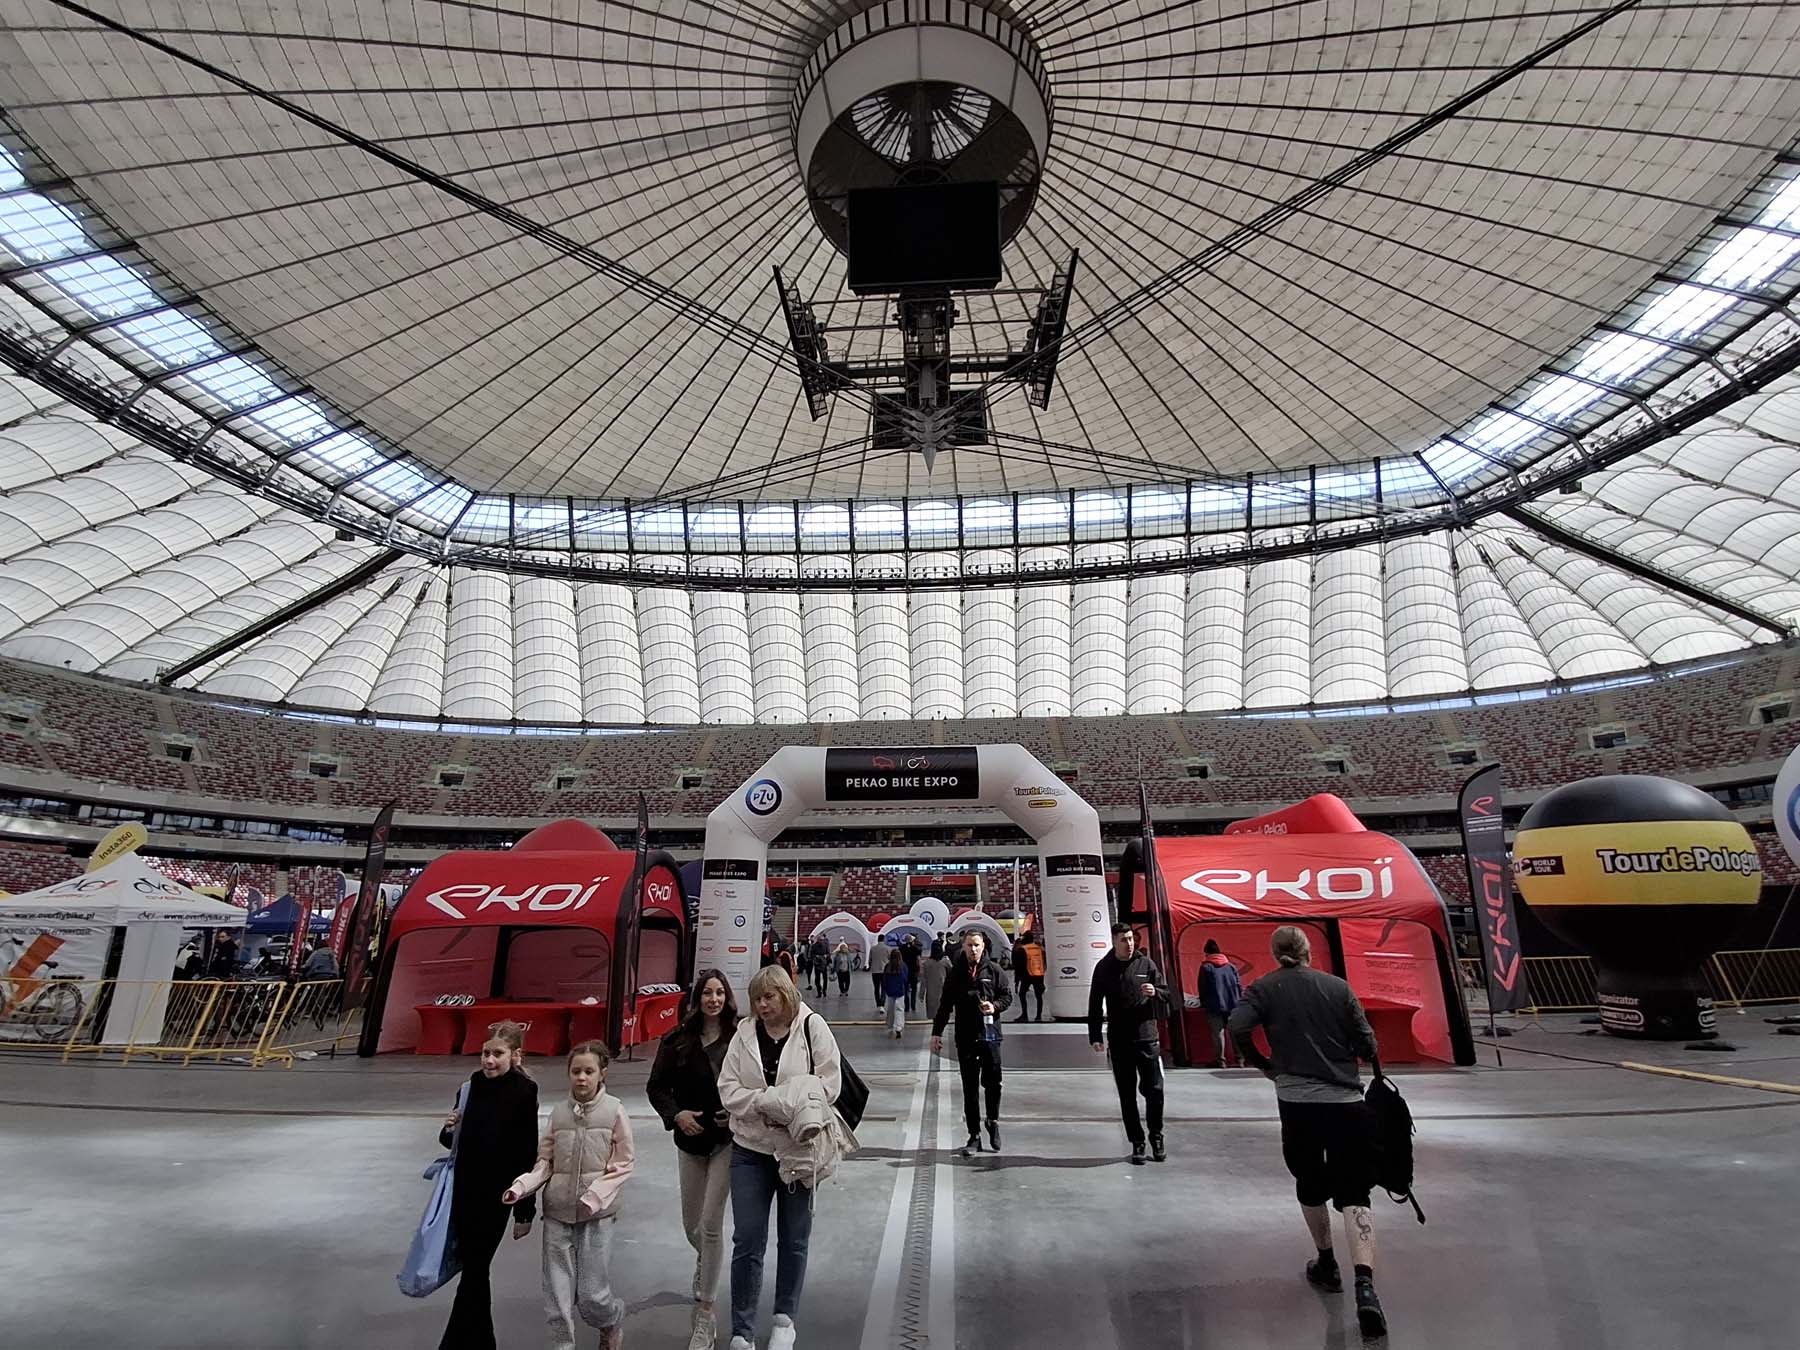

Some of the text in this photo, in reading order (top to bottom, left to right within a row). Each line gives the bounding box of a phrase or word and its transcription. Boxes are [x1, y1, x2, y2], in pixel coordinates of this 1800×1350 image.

[846, 776, 958, 788] PEKAO BIKE EXPO
[753, 789, 775, 805] PZU
[98, 831, 133, 860] Insta360
